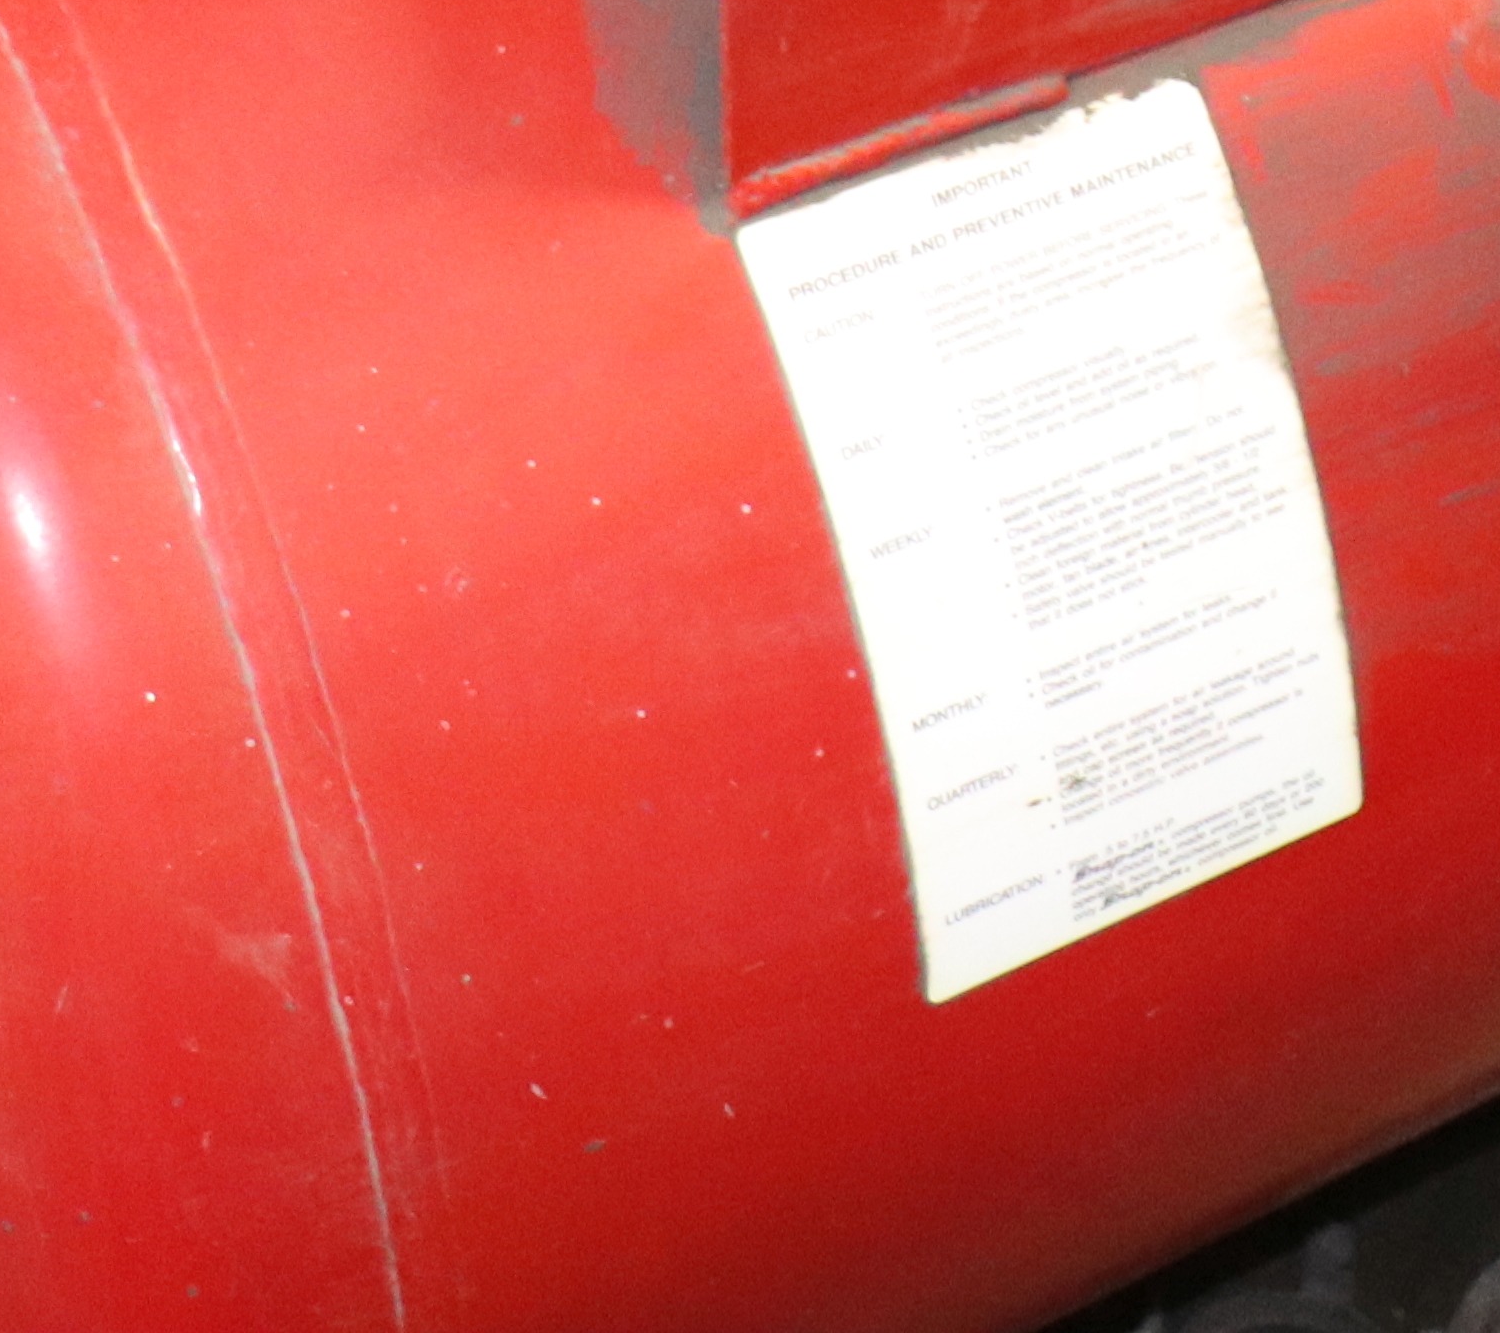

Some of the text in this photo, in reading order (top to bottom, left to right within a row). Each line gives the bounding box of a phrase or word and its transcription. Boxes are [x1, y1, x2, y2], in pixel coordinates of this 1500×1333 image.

[787, 142, 1196, 301] PROCEDURE AND PREVENTIVE MAINTENANCE
[930, 160, 1034, 205] IMPORTANT
